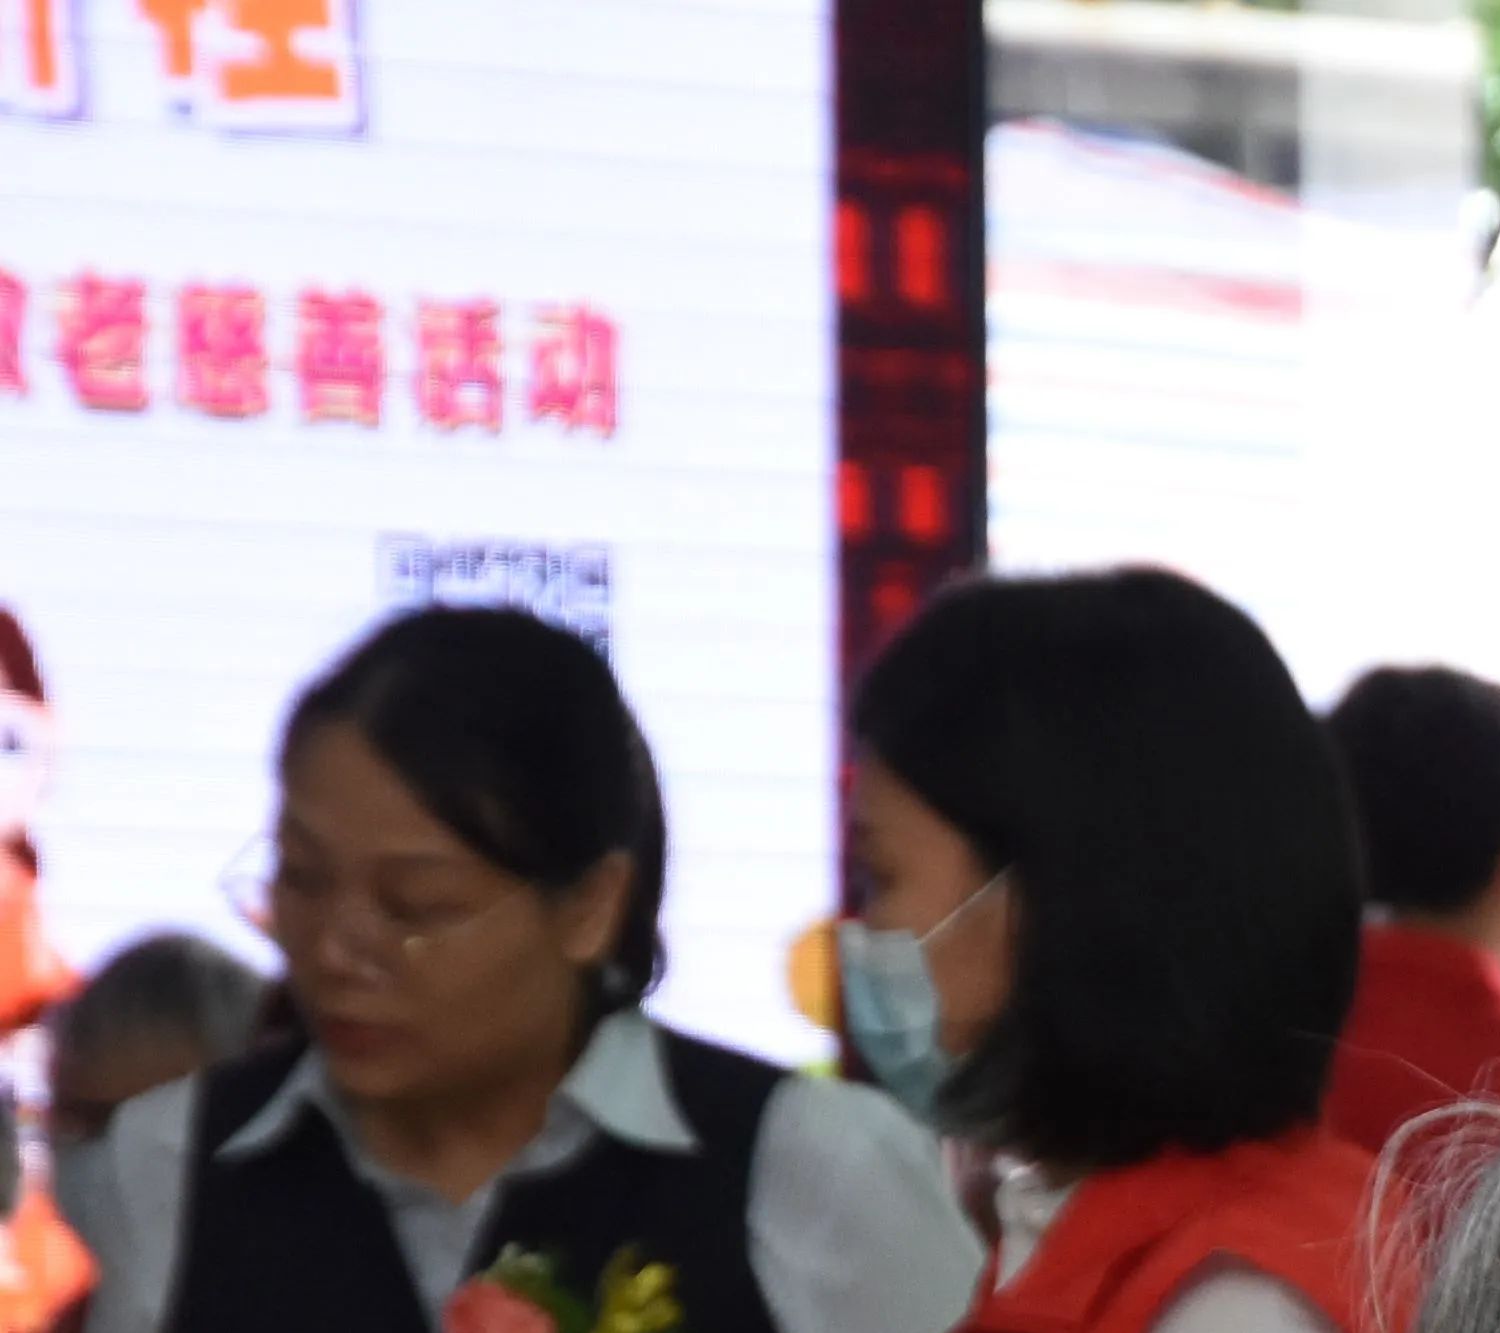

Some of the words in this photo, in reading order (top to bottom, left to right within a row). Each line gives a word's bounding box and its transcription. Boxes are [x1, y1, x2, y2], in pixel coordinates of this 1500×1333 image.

[0, 266, 618, 438] 老慈善活动
